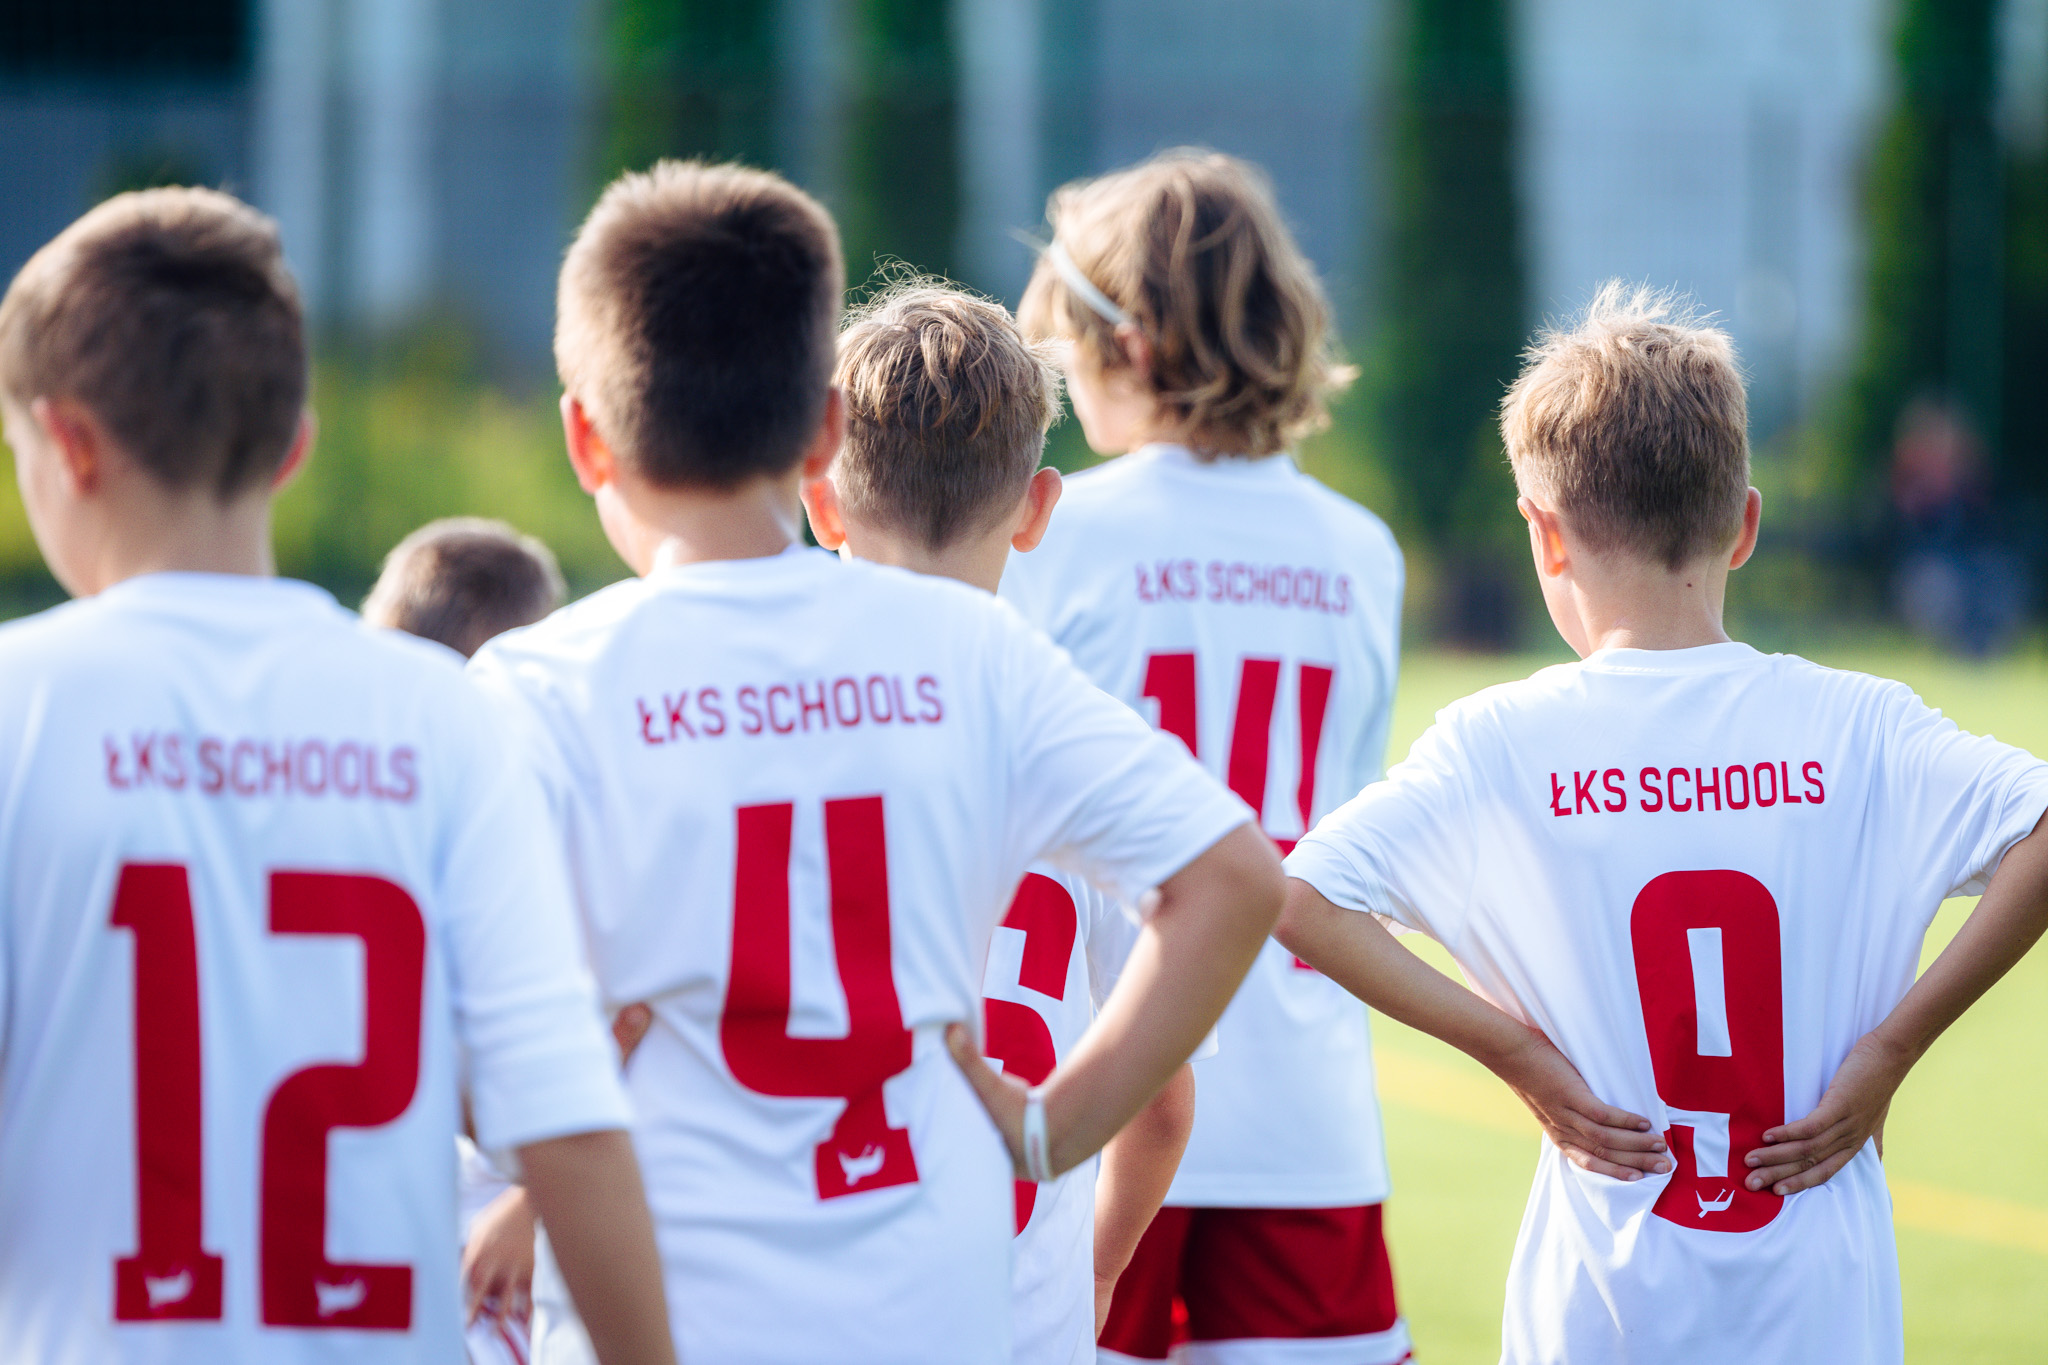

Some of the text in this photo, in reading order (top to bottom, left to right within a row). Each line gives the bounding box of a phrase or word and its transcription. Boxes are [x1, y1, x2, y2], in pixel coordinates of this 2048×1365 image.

[1206, 561, 1352, 616] SCHOOLS
[737, 674, 944, 737] SCHOOLS
[197, 736, 420, 805] SCHOOLS
[1639, 760, 1826, 813] SCHOOLS
[718, 793, 921, 1203] 4
[1629, 868, 1788, 1234] 9
[108, 860, 428, 1333] 12
